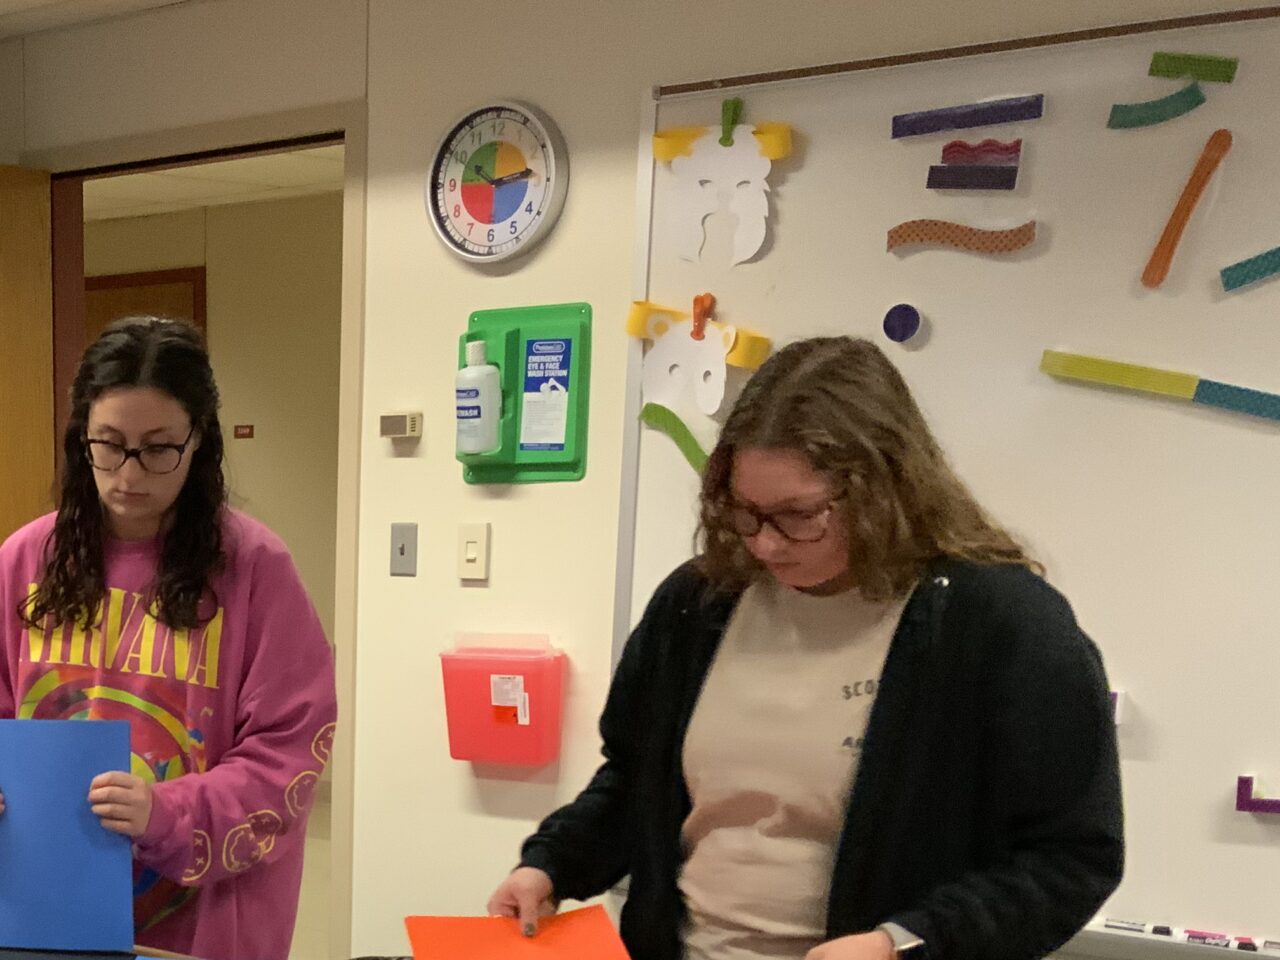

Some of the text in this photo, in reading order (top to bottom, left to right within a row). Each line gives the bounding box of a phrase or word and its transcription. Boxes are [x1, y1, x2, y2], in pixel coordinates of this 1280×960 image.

[491, 123, 505, 136] 12
[517, 130, 524, 141] 1
[471, 132, 482, 143] 11
[454, 151, 468, 165] 10
[449, 178, 456, 192] 9
[454, 204, 460, 217] 8
[525, 201, 533, 215] 4
[467, 223, 474, 236] 7
[510, 221, 517, 234] 5
[487, 229, 495, 242] 6
